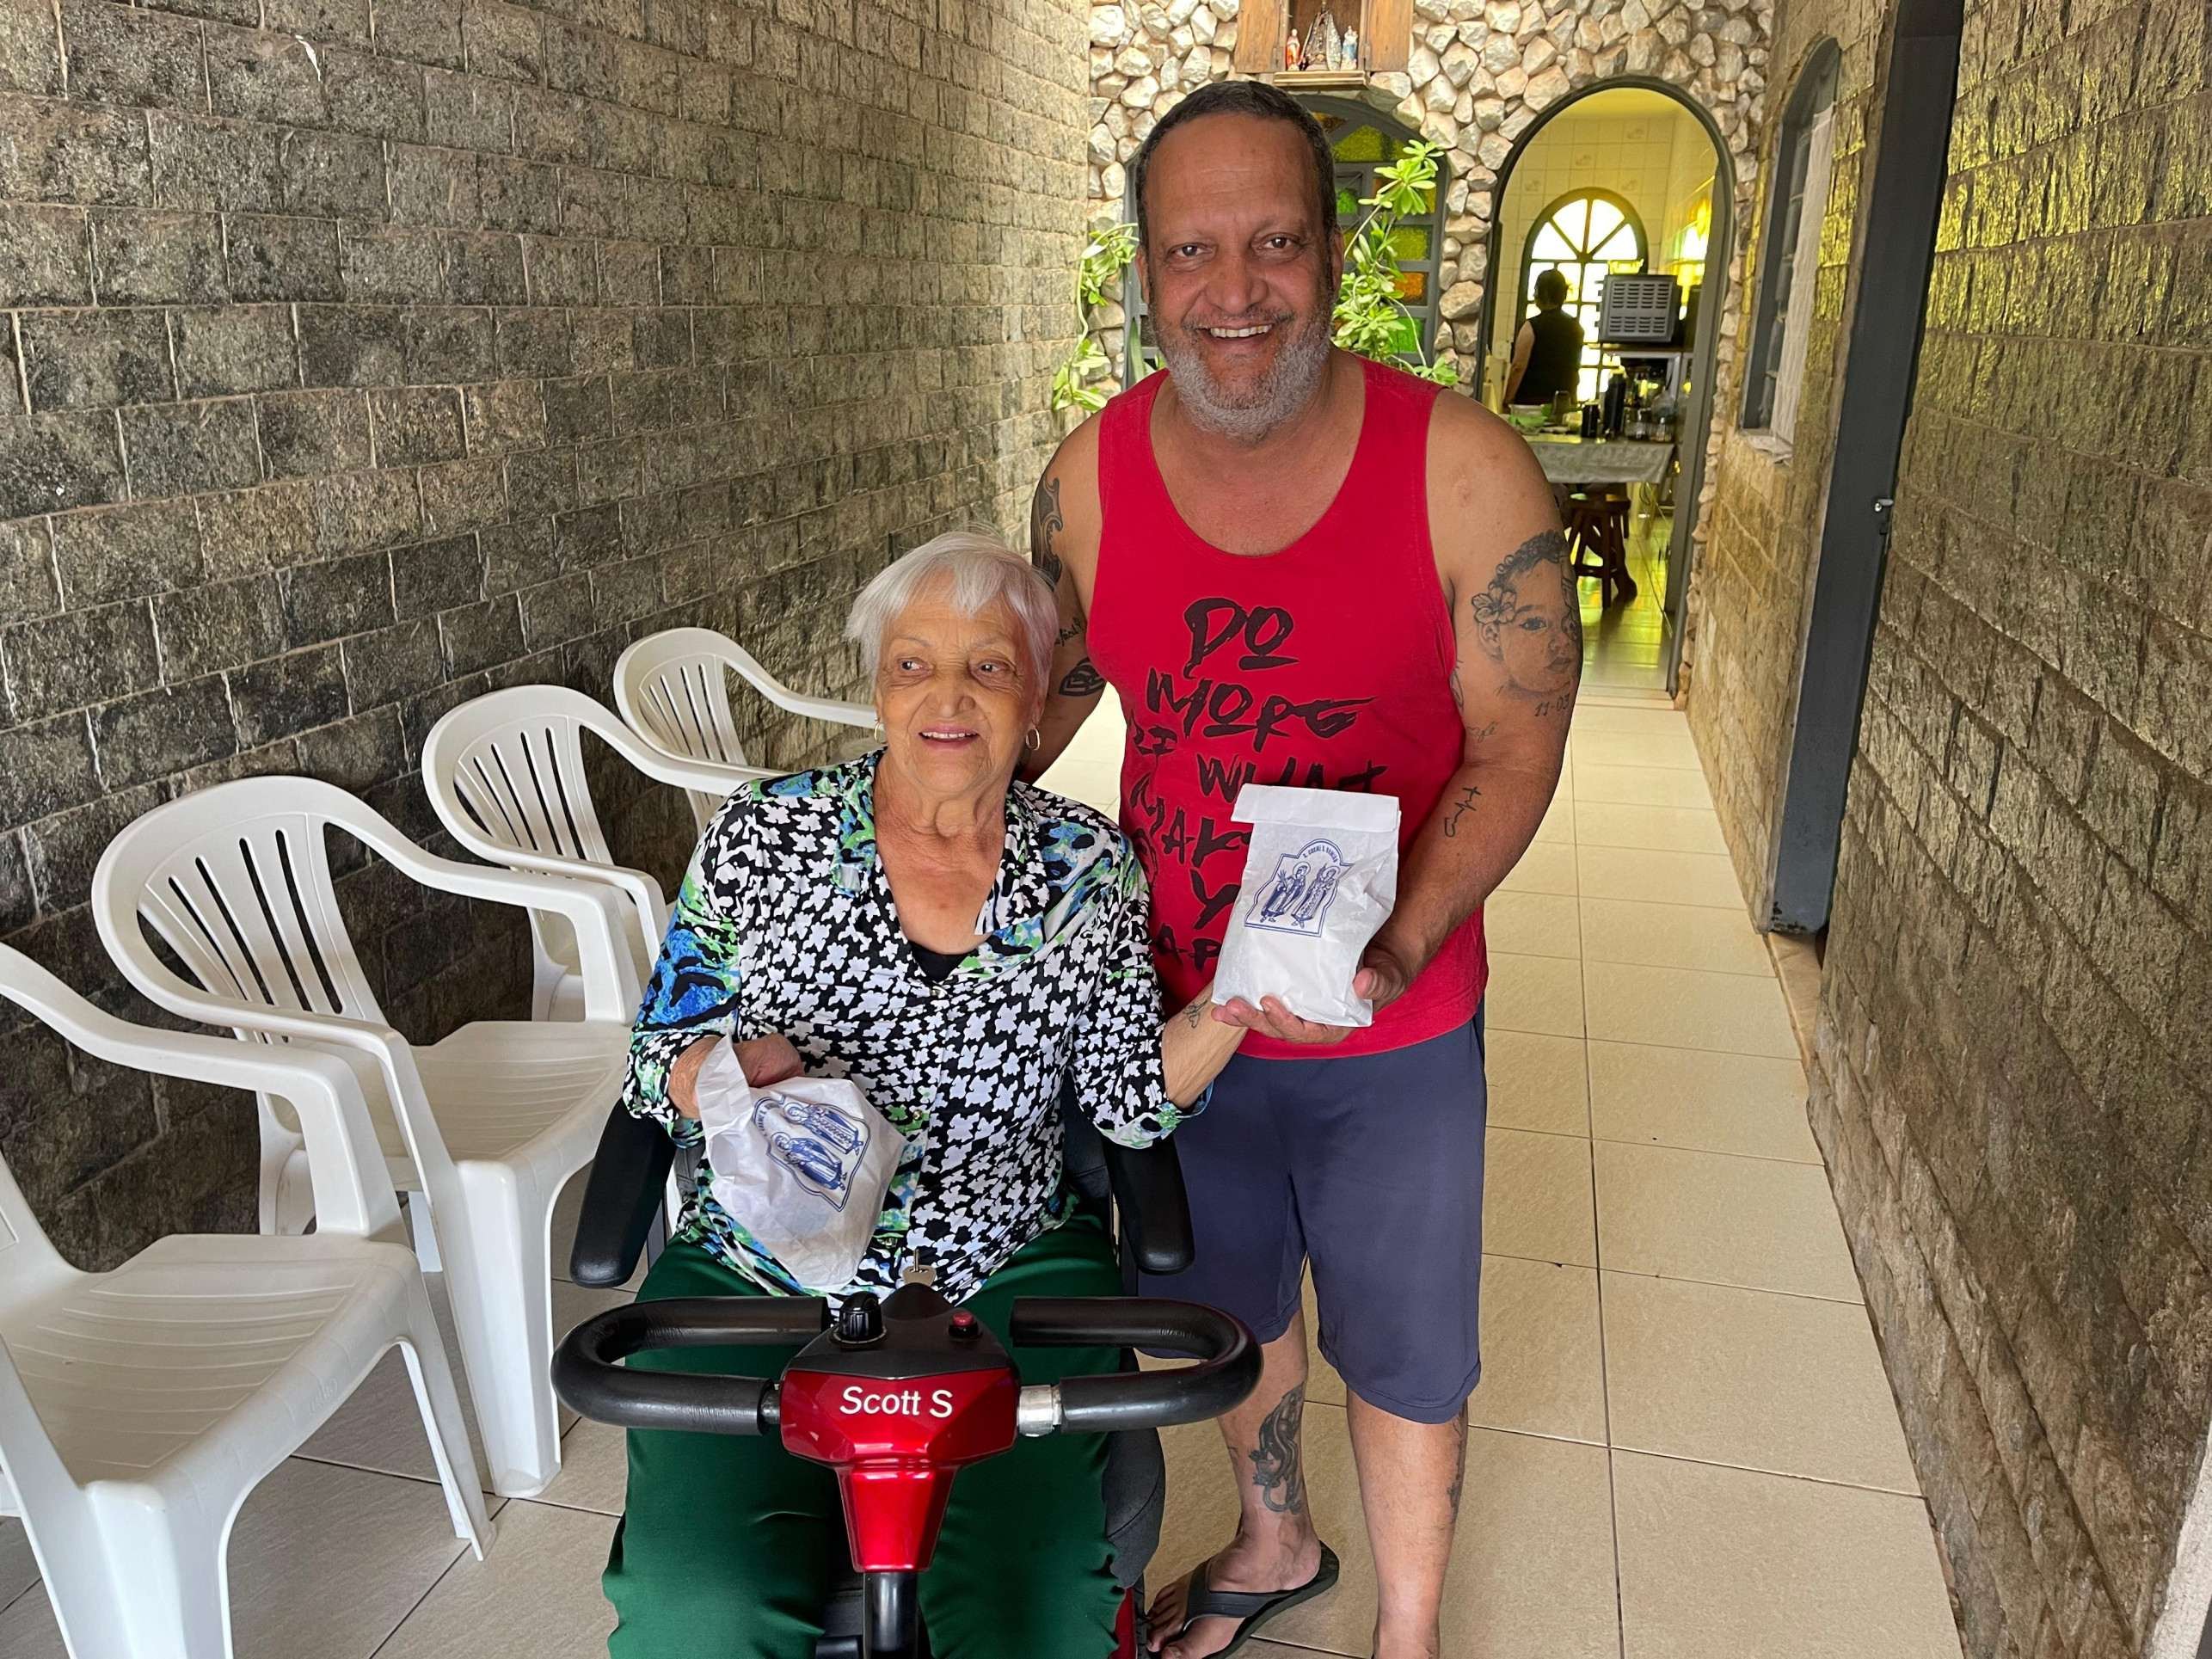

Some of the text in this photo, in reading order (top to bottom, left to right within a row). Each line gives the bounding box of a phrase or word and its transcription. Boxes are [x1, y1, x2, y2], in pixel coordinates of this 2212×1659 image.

[1183, 597, 1300, 679] DO
[1146, 667, 1377, 752] MORE
[839, 1386, 953, 1418] Scott S
